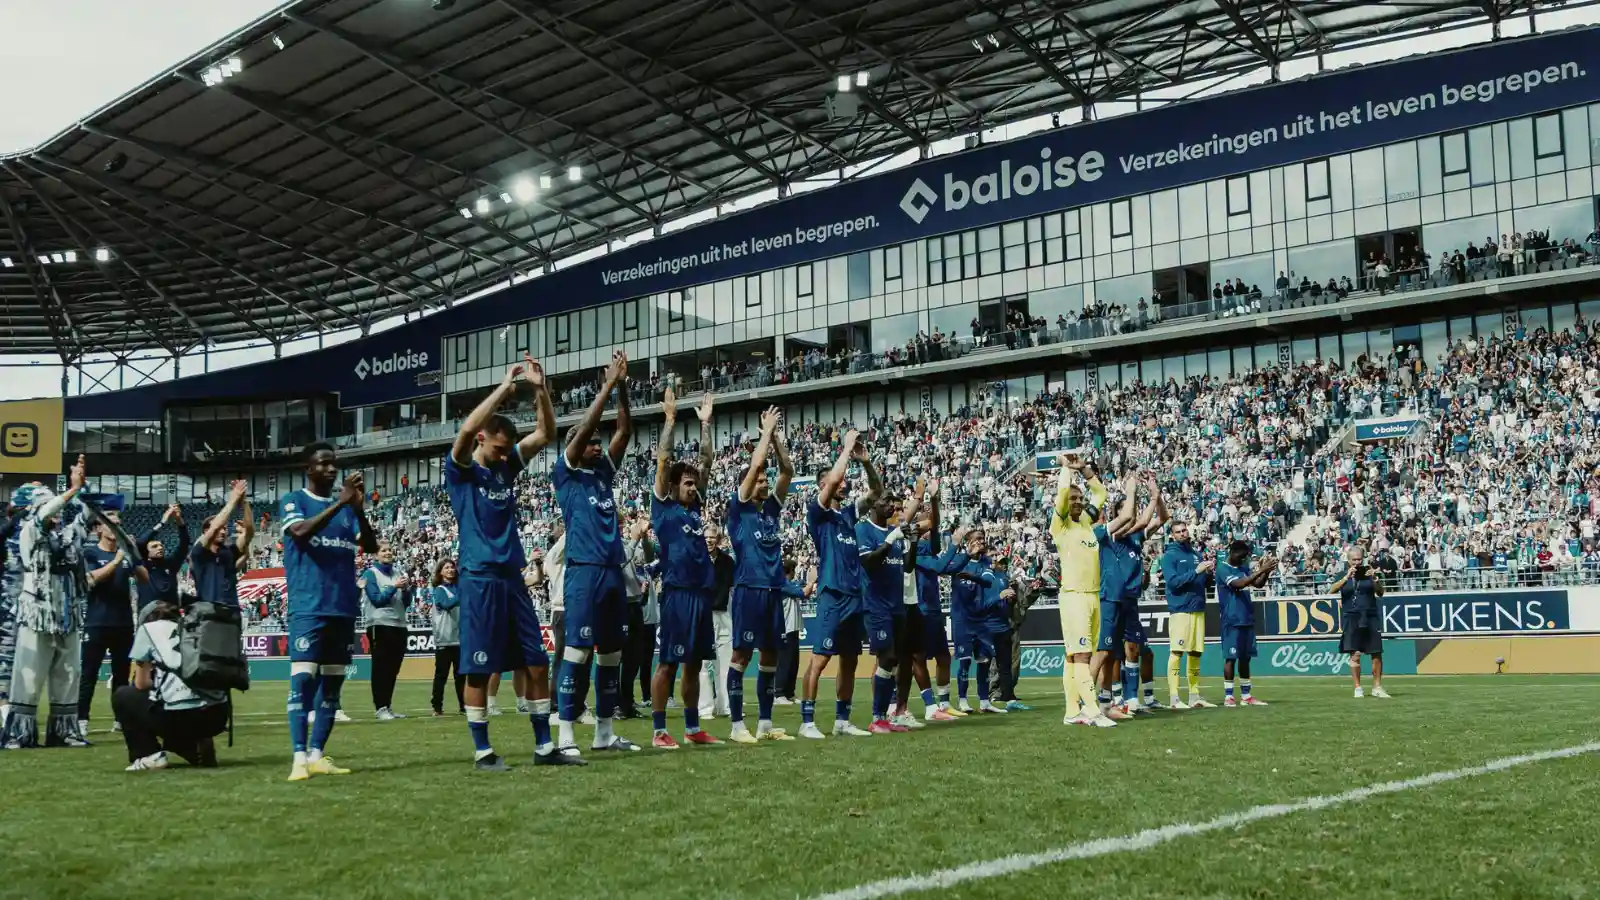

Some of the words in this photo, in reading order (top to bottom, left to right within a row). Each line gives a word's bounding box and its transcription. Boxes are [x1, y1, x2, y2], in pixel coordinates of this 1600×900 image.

[1118, 127, 1278, 174] Verzekeringen
[1283, 114, 1315, 140] uit
[1319, 105, 1362, 132] het
[1366, 93, 1436, 122] leven
[1441, 61, 1587, 106] begrepen.
[944, 147, 1105, 212] baloise
[601, 254, 699, 286] Verzekeringen
[700, 246, 721, 265] uit
[723, 240, 749, 260] het
[751, 233, 793, 254] leven
[795, 213, 880, 245] begrepen.
[372, 348, 428, 376] baloise
[1088, 370, 1097, 393] 324
[922, 393, 930, 413] 324
[1380, 424, 1408, 434] baloise
[1277, 600, 1343, 634] DS
[1382, 600, 1556, 633] KEUKENS.
